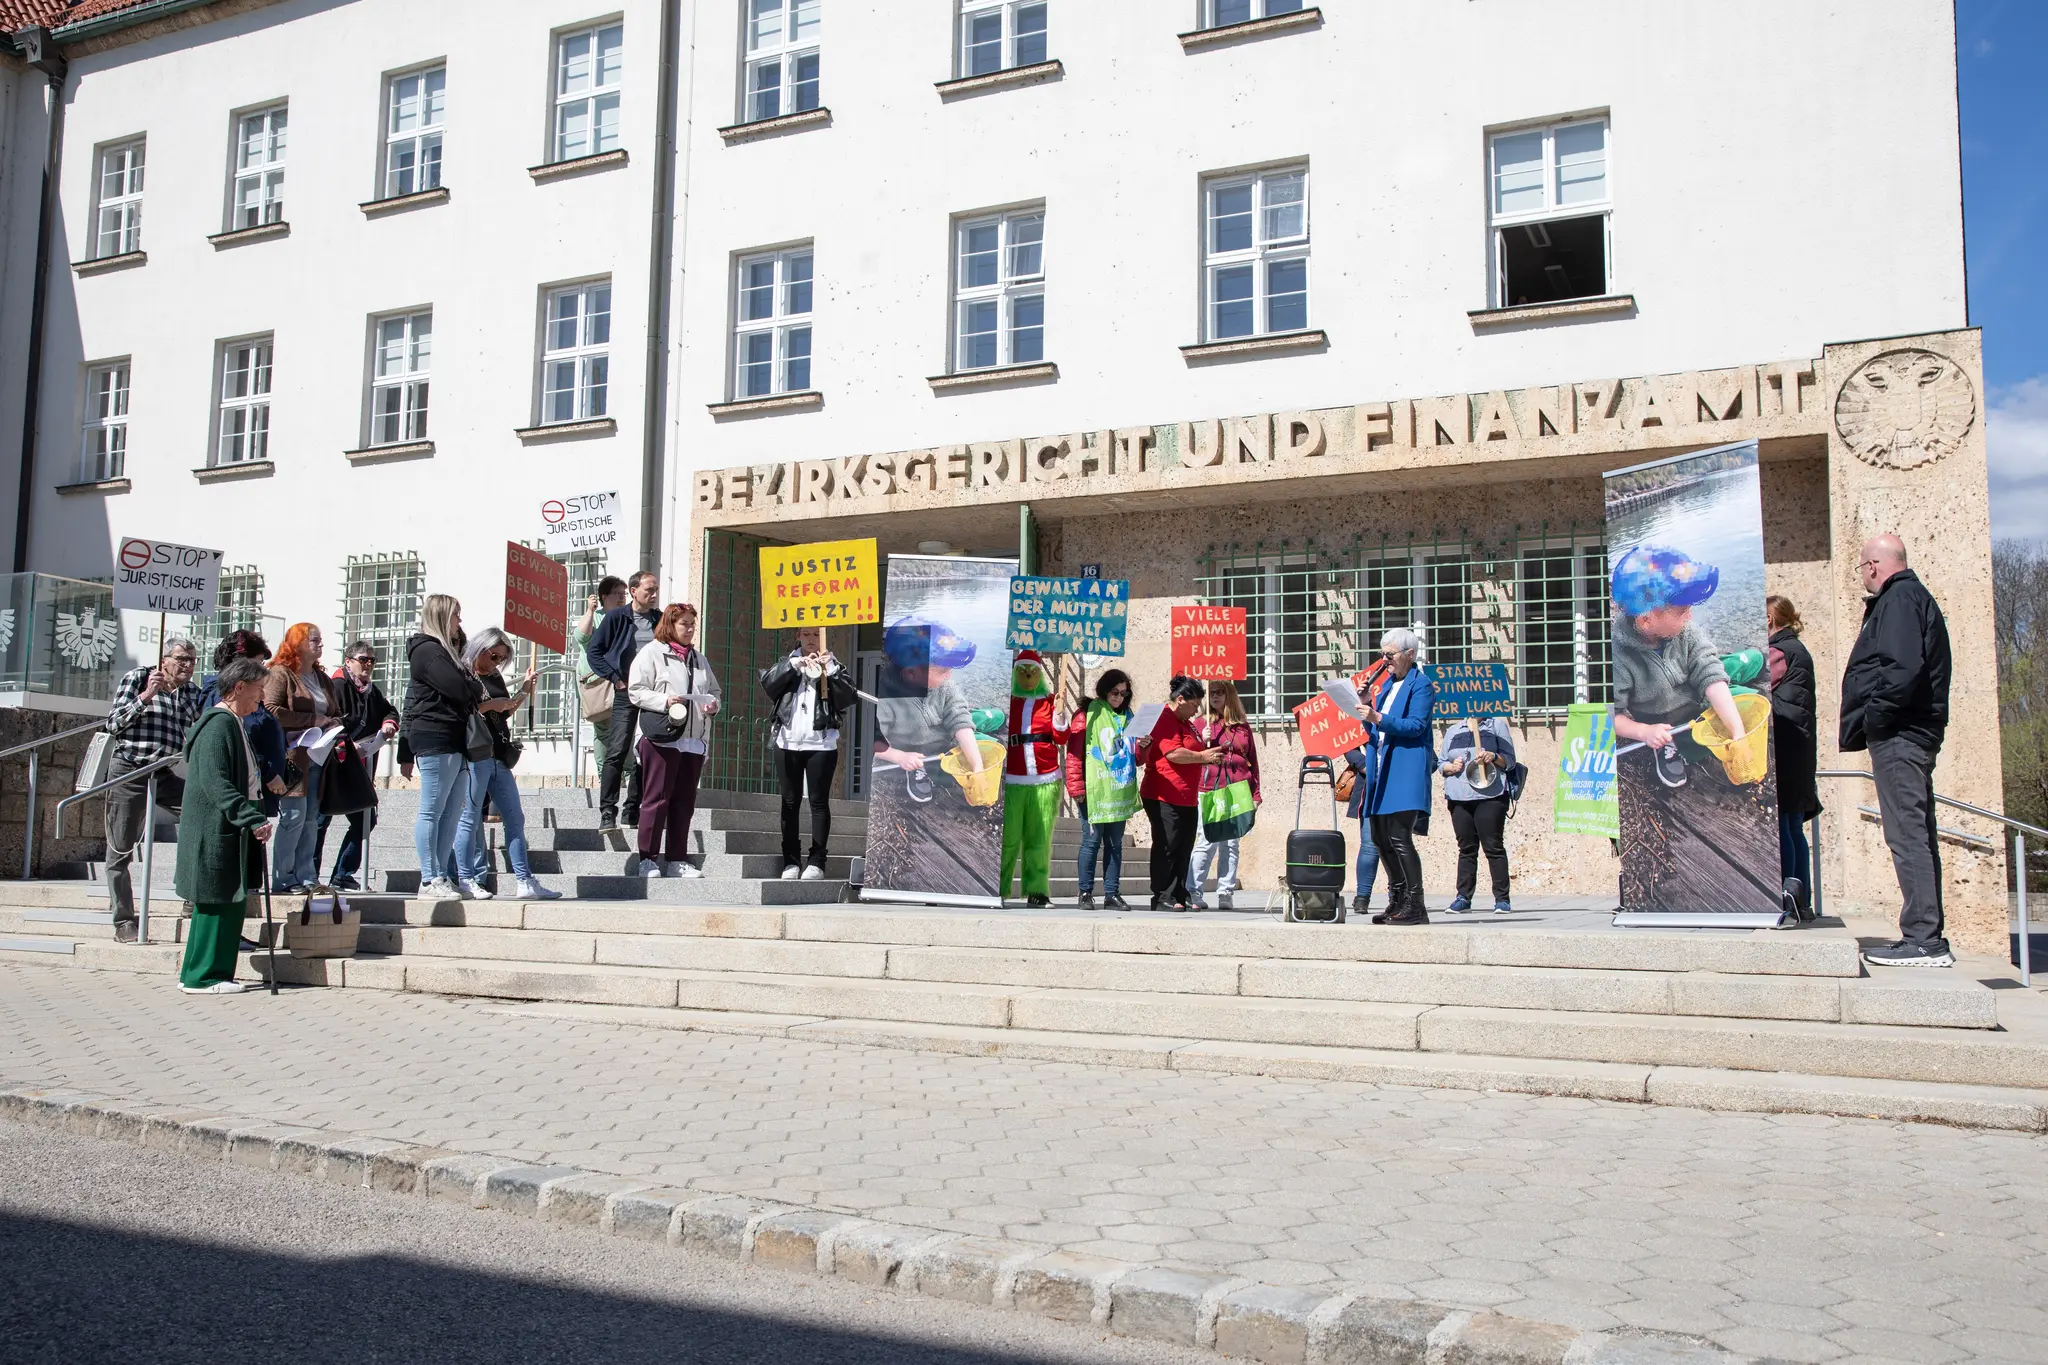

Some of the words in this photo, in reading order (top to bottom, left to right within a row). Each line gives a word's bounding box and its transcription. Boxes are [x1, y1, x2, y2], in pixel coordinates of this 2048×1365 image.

[695, 425, 1156, 511] BEZIRKSGERICHT
[1179, 411, 1327, 469] UND
[1354, 359, 1812, 451] FINANZAMT
[546, 515, 612, 535] JURISTISCHE
[571, 530, 616, 547] WILLKÜR
[509, 549, 563, 585] GEWALT
[775, 556, 857, 577] JUSTIZ
[1083, 565, 1097, 576] 16
[119, 568, 206, 591] JURISTISCHE
[777, 577, 860, 598] REFORM
[507, 574, 563, 607] BEENDET
[1011, 580, 1081, 595] GEWALT
[1088, 581, 1119, 598] AN
[147, 594, 204, 613] WILLKÜR
[1013, 599, 1044, 614] DER
[505, 599, 565, 636] OBSORGE
[1186, 609, 1230, 621] VIELE
[1173, 623, 1245, 638] STIMMEN
[1007, 631, 1034, 646] AM
[1072, 636, 1122, 653] KIND
[1191, 640, 1226, 657] FÜR
[1184, 664, 1234, 678] LUKAS
[1435, 665, 1493, 679] STARKE
[1432, 679, 1503, 693] STIMMEN
[1299, 697, 1328, 719] WER
[1432, 699, 1459, 715] FÜR
[1466, 700, 1512, 714] LUKAS
[1310, 718, 1329, 737] AN
[1308, 854, 1325, 865] JBL
